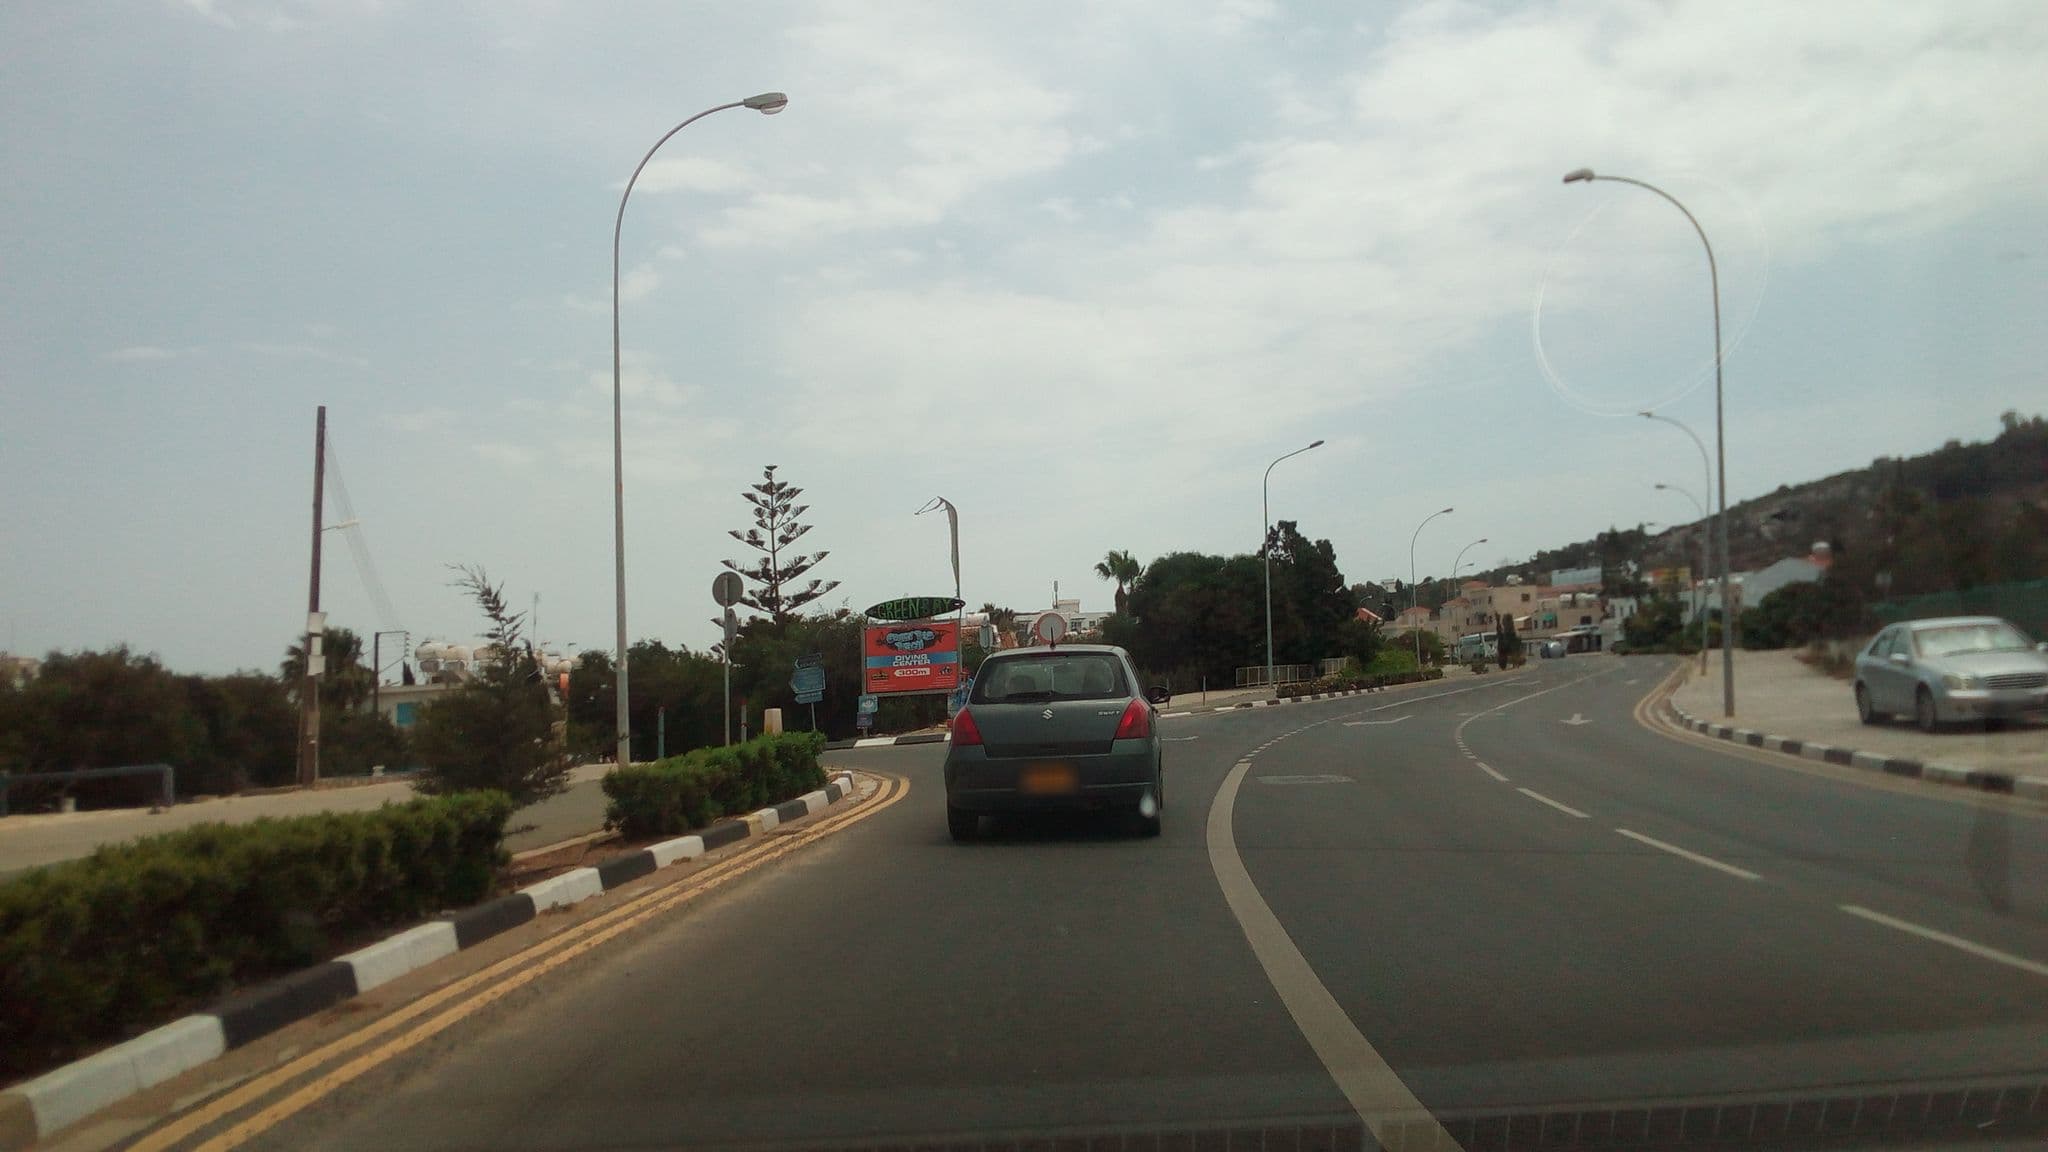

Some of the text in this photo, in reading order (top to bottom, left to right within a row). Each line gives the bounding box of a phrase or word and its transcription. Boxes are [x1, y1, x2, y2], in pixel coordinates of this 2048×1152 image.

[878, 599, 920, 619] GREEN
[895, 653, 928, 662] DIVING
[892, 659, 931, 667] CENTER
